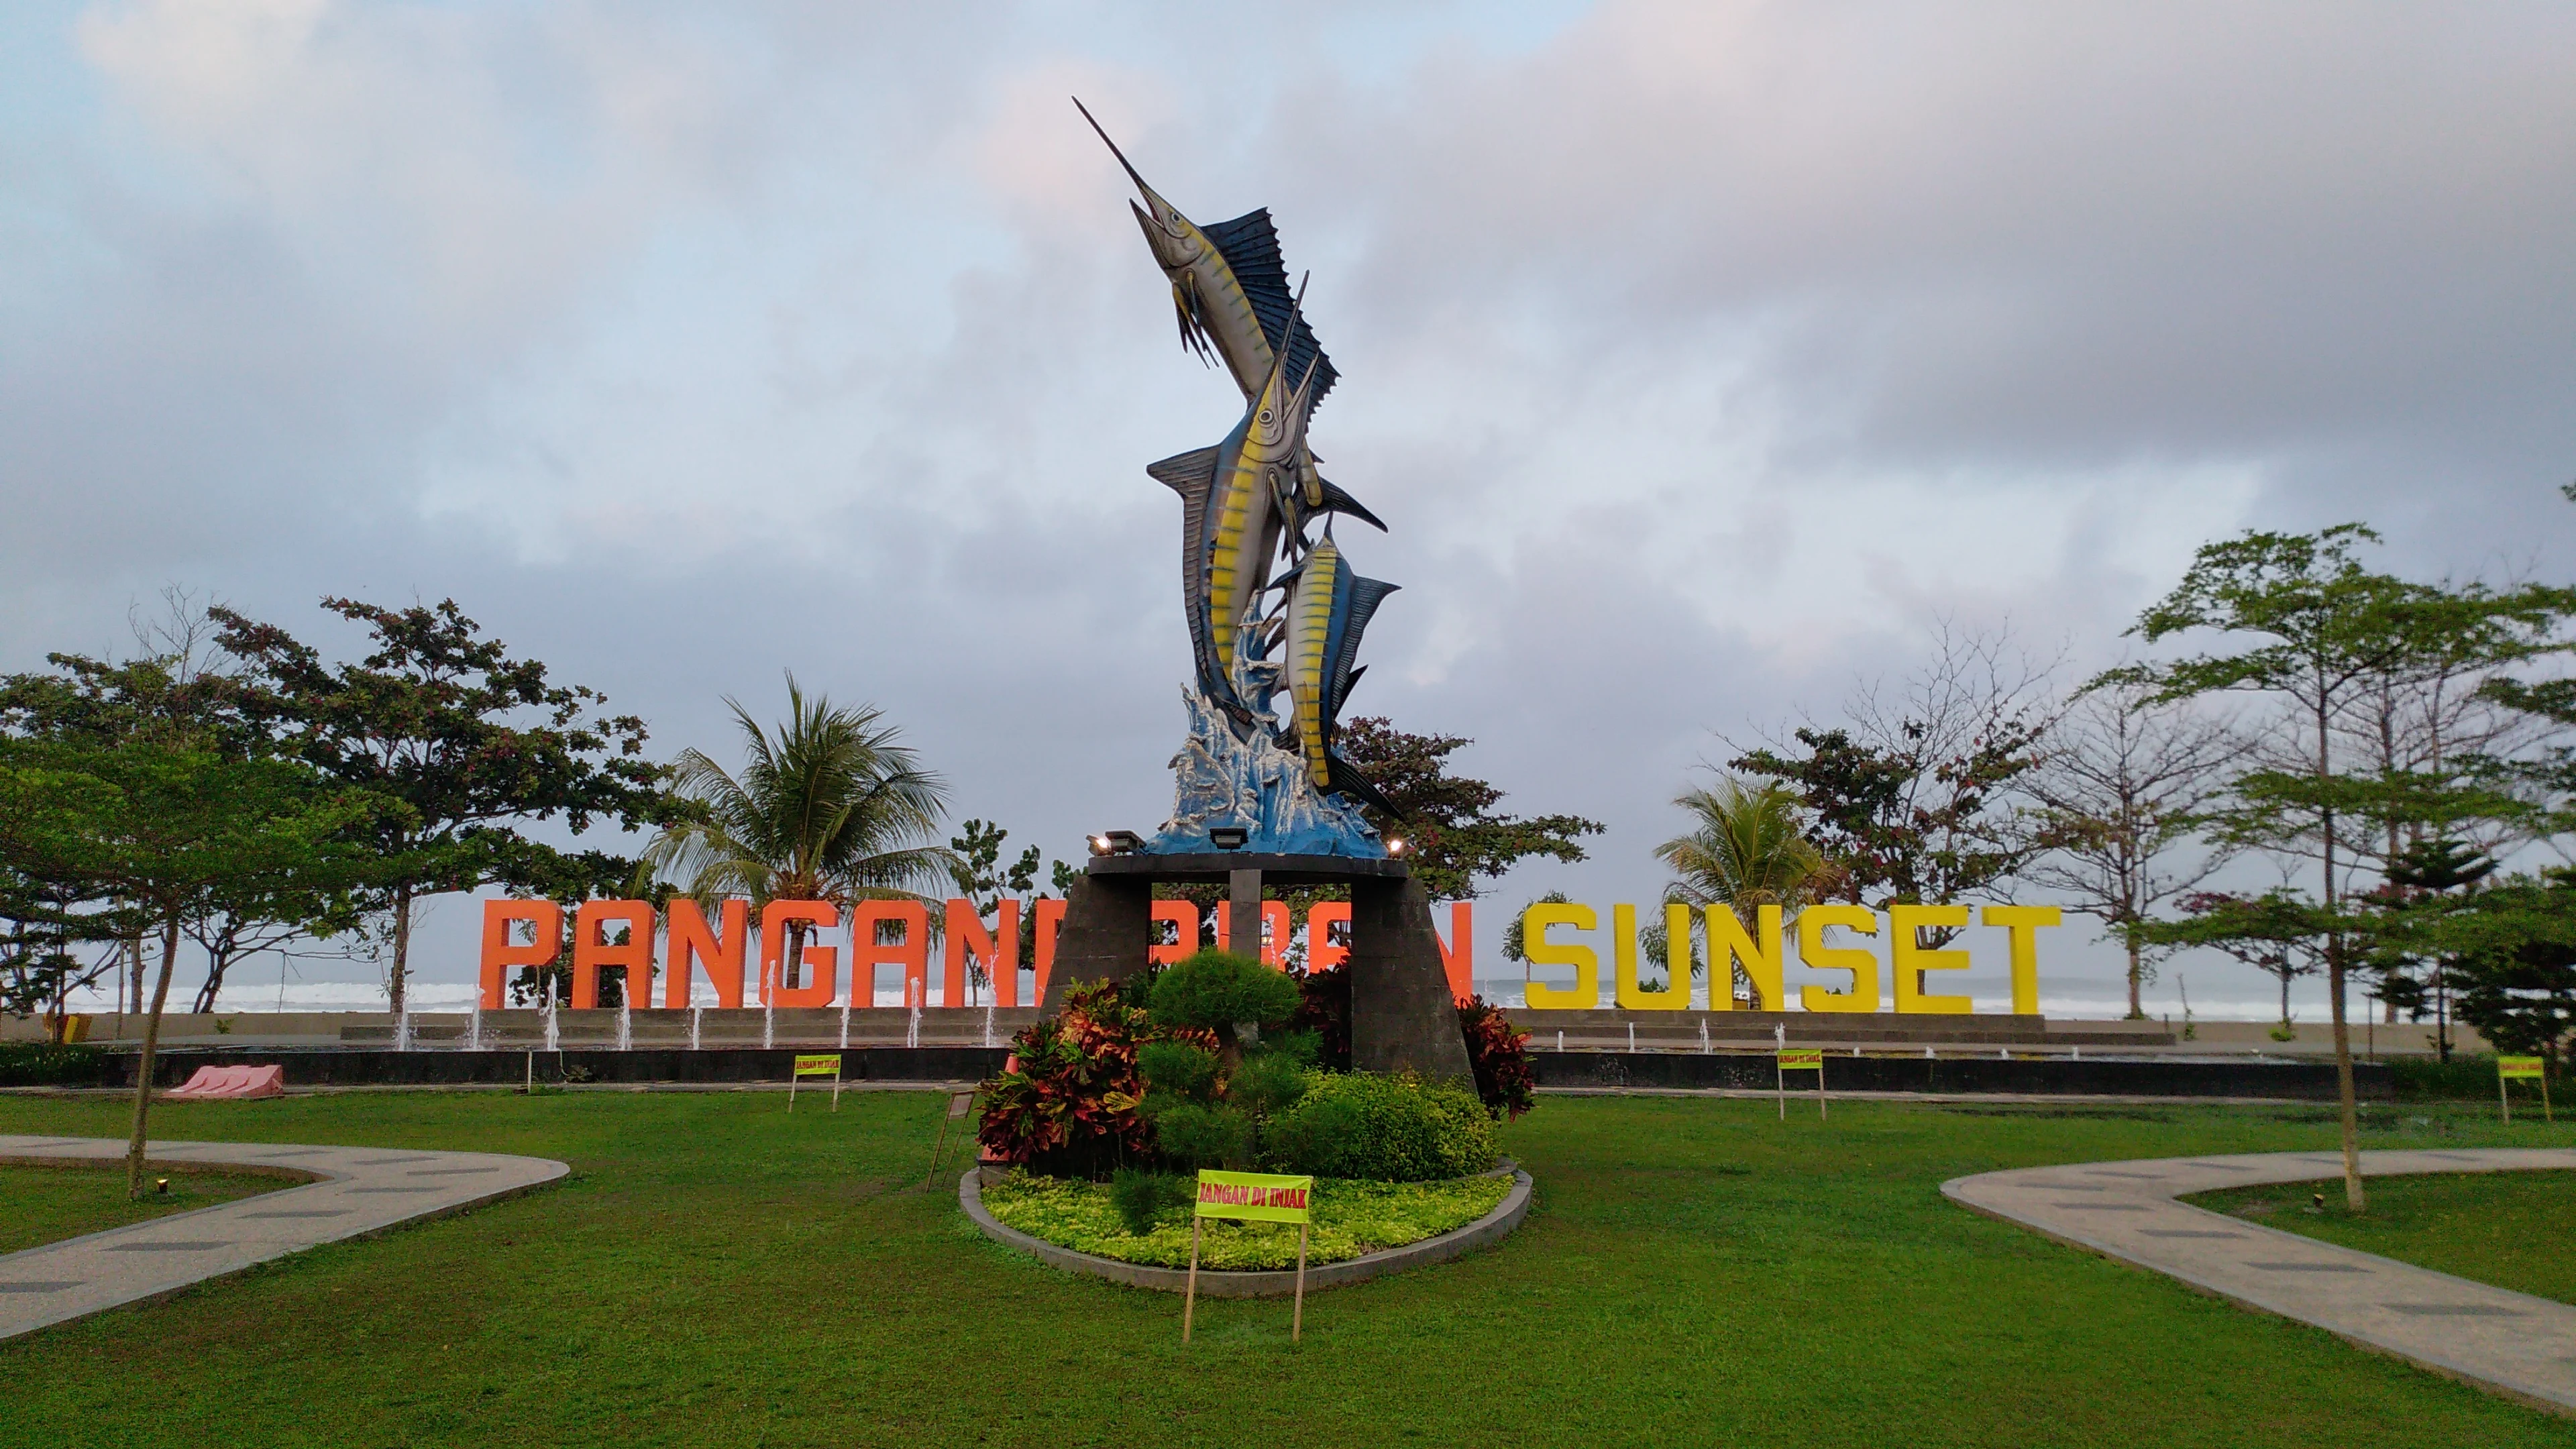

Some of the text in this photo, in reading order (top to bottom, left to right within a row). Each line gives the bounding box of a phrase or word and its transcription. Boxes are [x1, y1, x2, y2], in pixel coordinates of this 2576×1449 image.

[479, 899, 2061, 1015] PANGANN SUNSET
[1198, 1182, 1307, 1210] JANGAN DI INJAK
